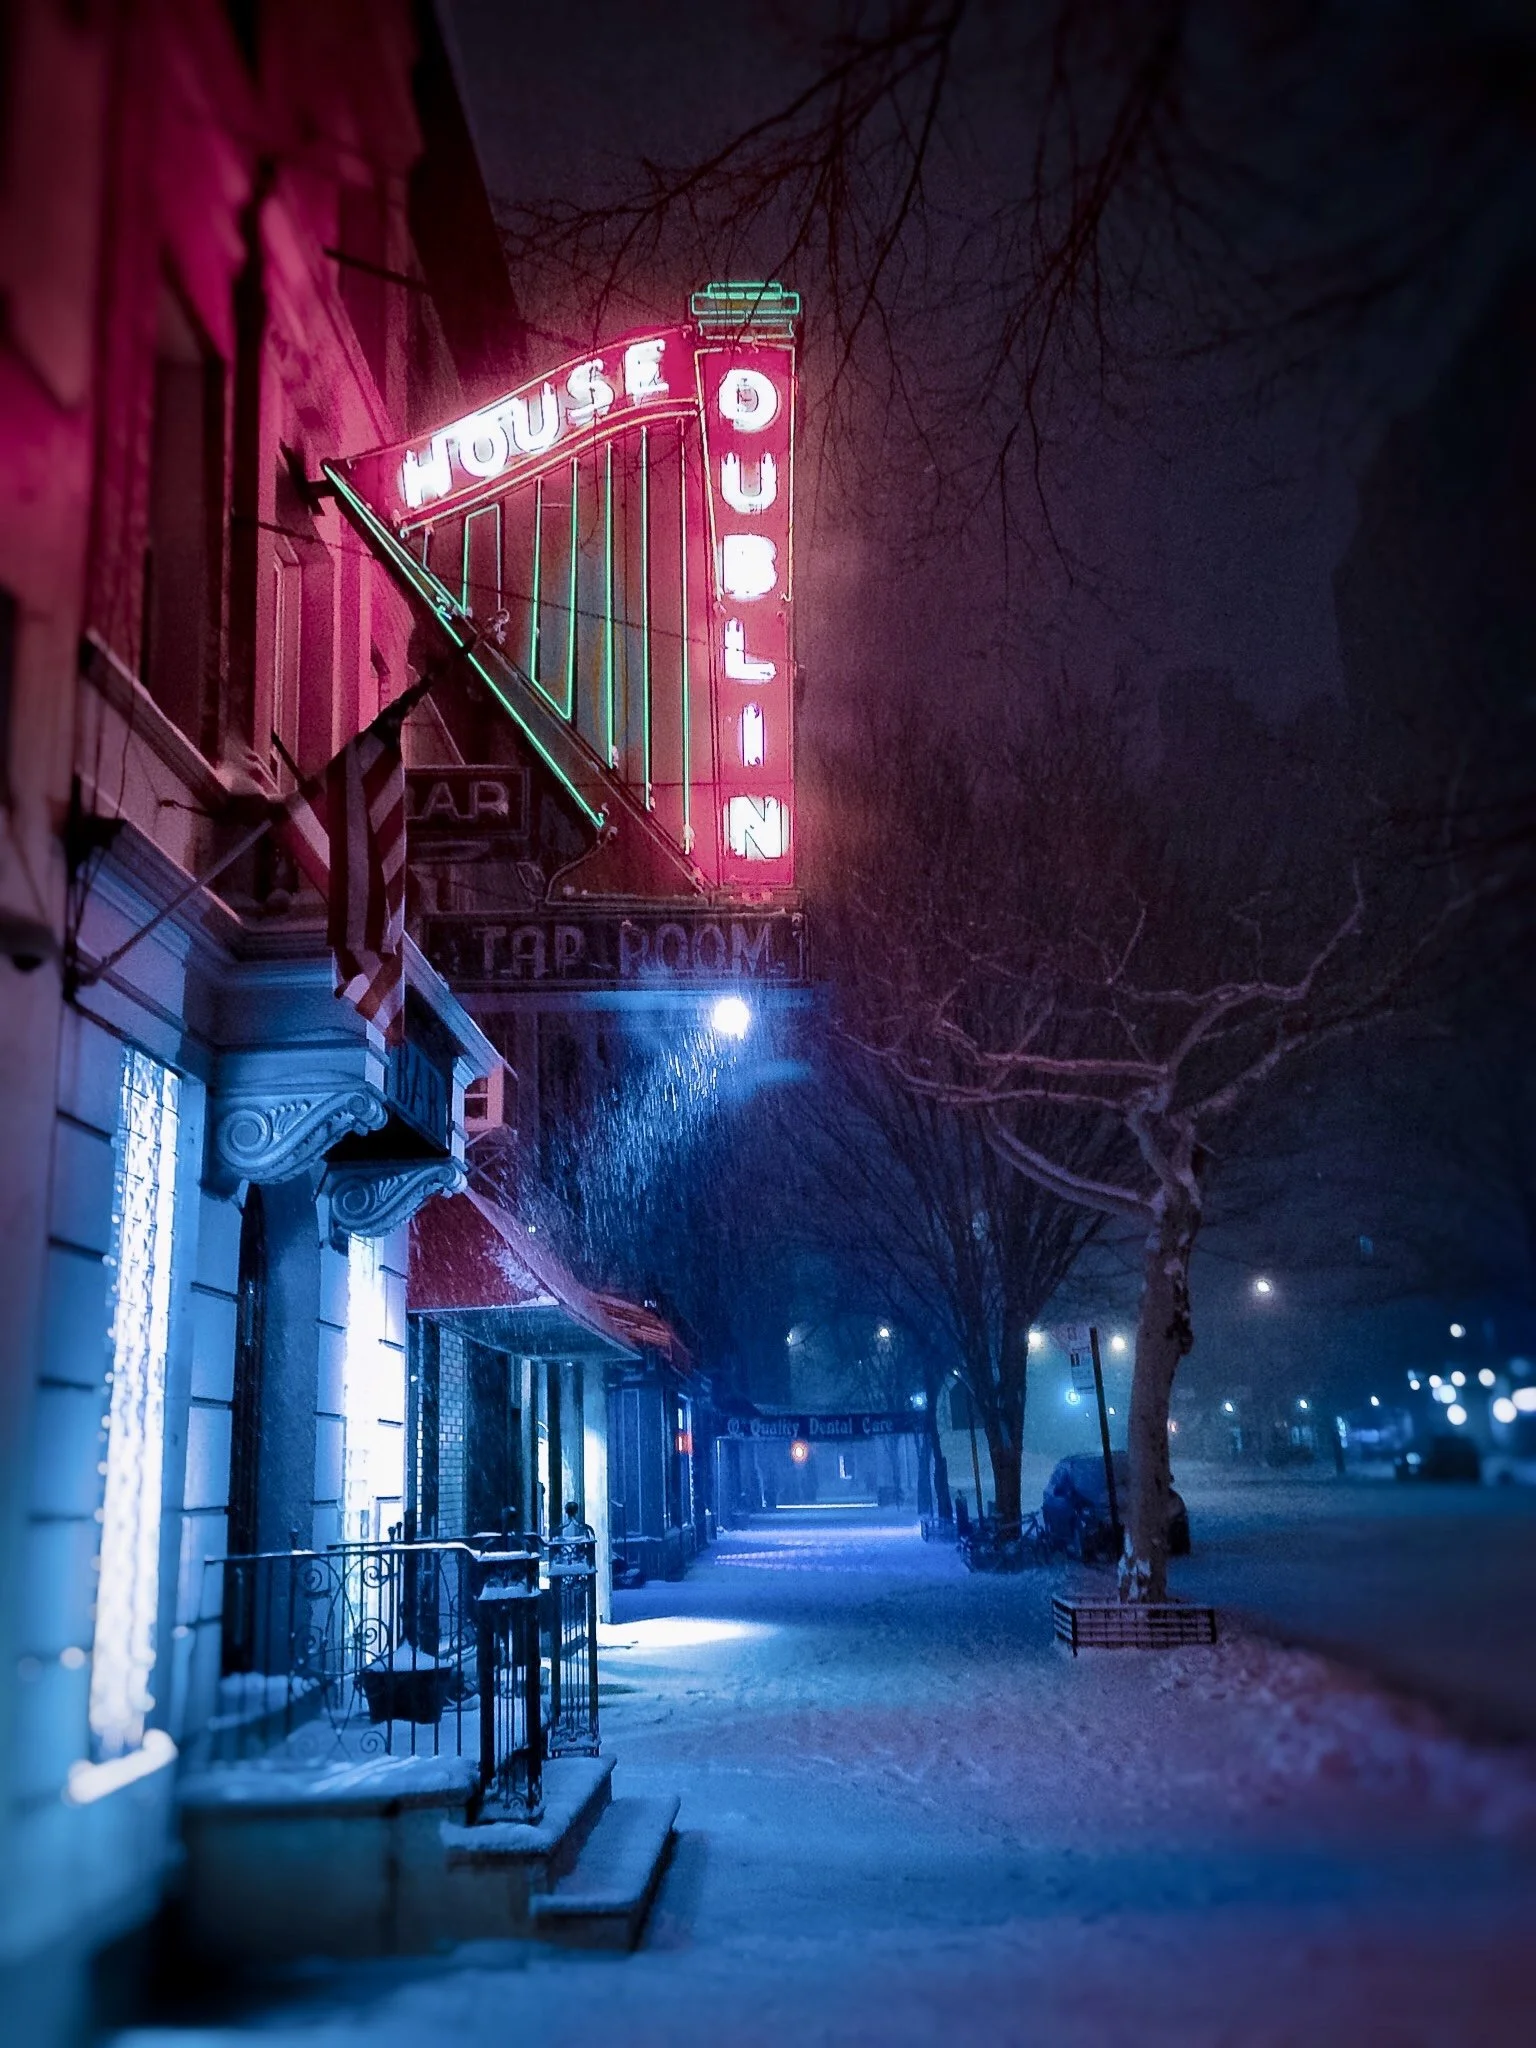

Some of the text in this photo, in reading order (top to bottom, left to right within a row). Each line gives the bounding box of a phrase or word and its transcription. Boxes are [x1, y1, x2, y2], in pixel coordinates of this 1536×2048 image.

[401, 338, 670, 508] HOUSE
[718, 368, 790, 861] DUBLIN
[406, 781, 509, 823] AR
[471, 921, 774, 980] TAP ROOM
[749, 1417, 800, 1438] Quality
[808, 1416, 853, 1435] Dental
[862, 1416, 894, 1434] Care
